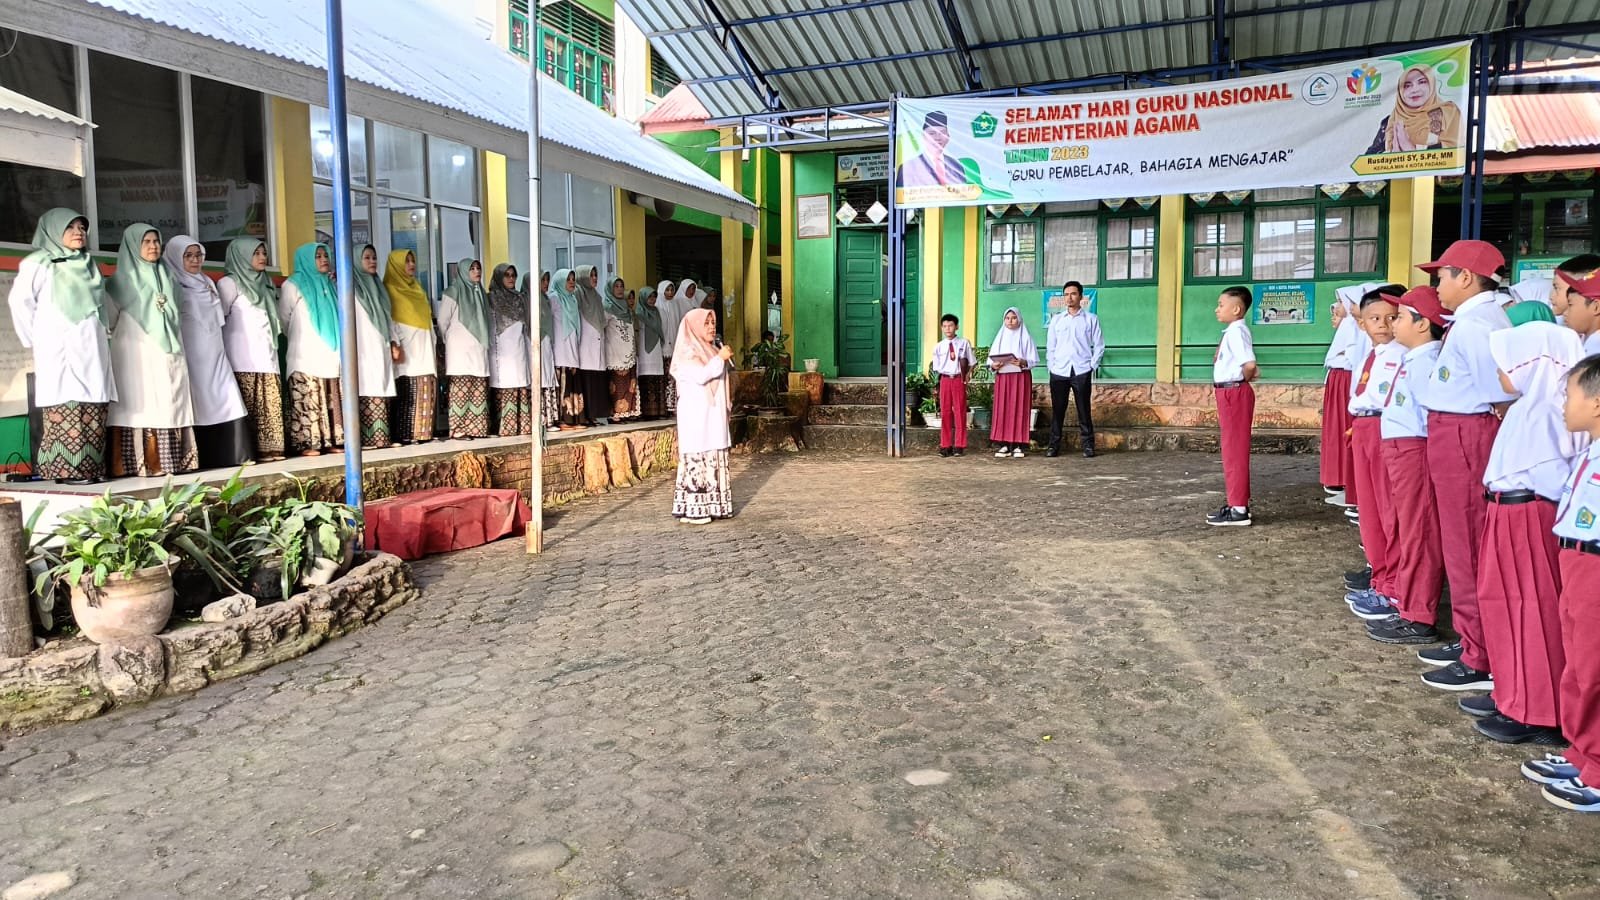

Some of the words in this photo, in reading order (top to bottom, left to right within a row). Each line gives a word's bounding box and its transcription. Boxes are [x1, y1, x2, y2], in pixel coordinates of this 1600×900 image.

[1005, 104, 1082, 124] SELAMAT
[1088, 99, 1130, 119] HARI
[1136, 93, 1188, 115] GURU
[1194, 83, 1293, 109] NASIONAL
[1005, 120, 1129, 144] KEMENTERIAN
[1134, 112, 1200, 137] AGAMA
[1004, 148, 1049, 163] TAHUN
[1051, 145, 1089, 160] 2023
[1367, 154, 1405, 165] Rusdayetti
[1420, 152, 1438, 161] S.Pd,
[1440, 151, 1453, 159] MM
[1049, 162, 1133, 179] PEMBELAJAR,
[1140, 157, 1202, 173] BAHAGIA
